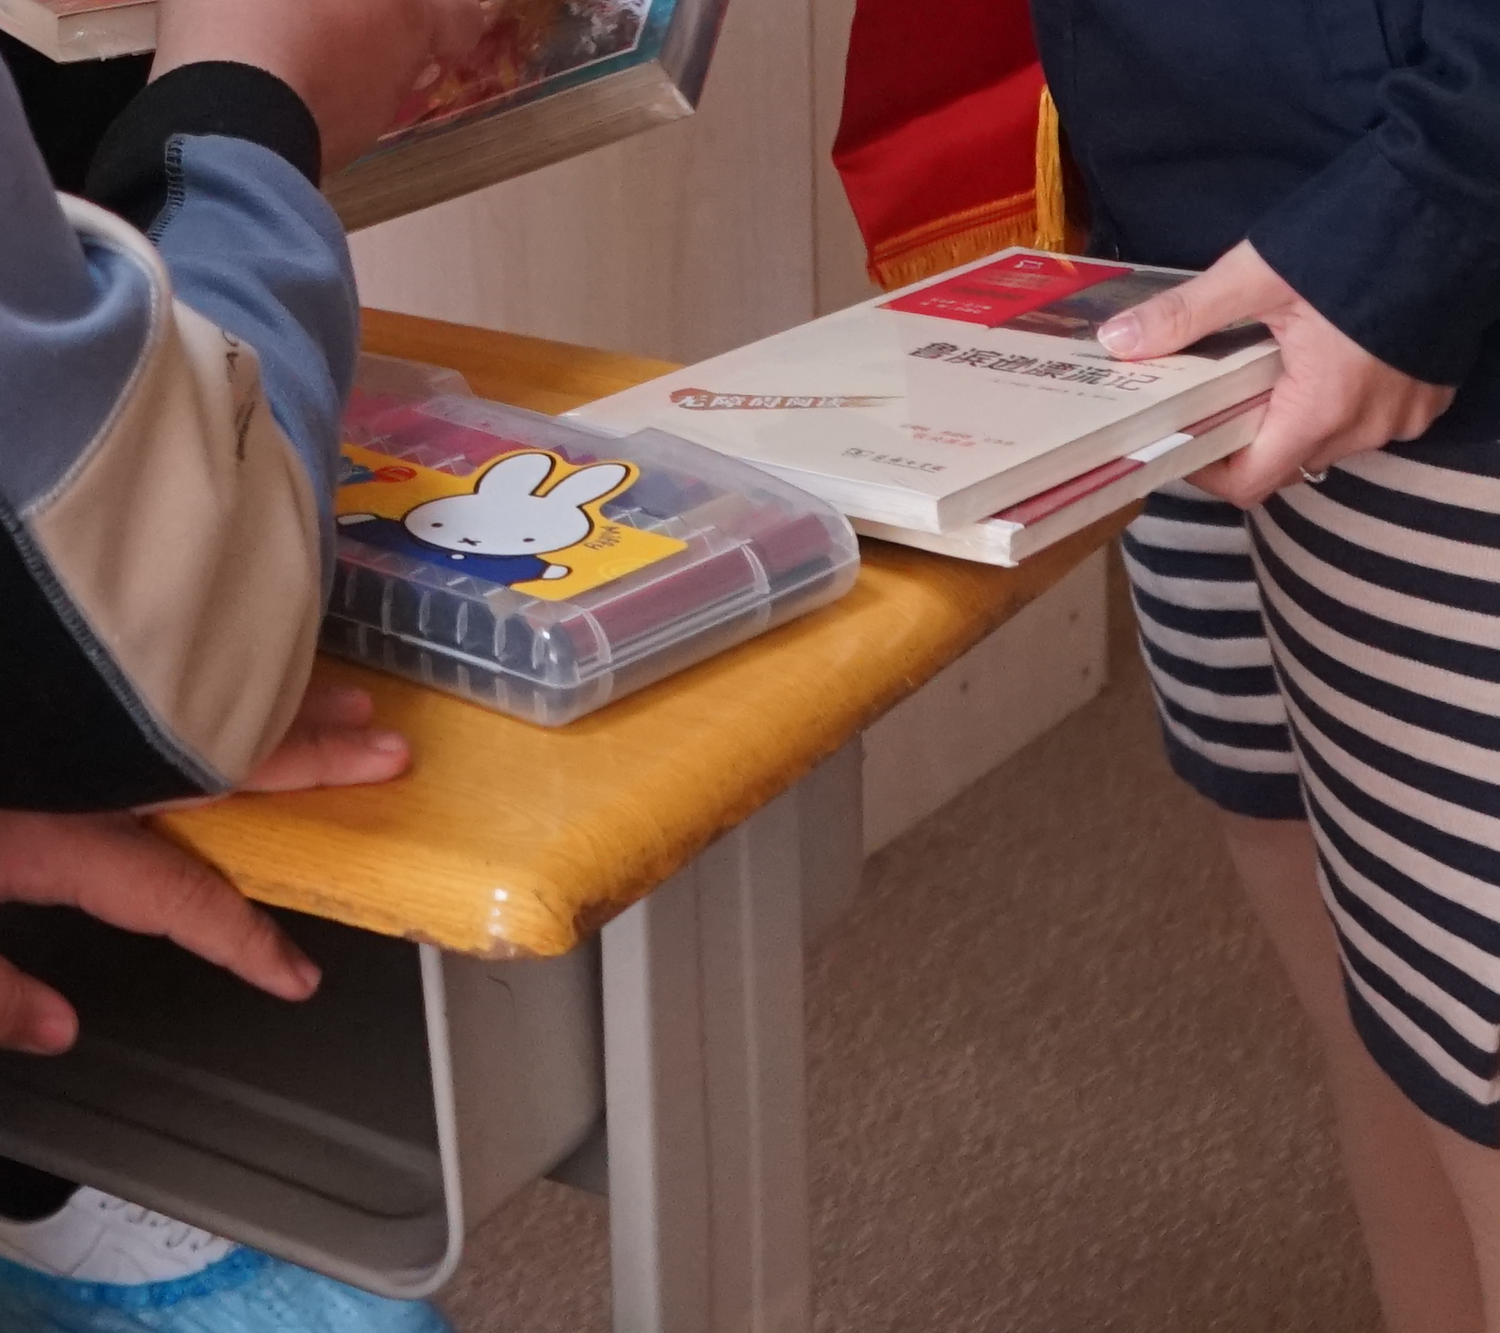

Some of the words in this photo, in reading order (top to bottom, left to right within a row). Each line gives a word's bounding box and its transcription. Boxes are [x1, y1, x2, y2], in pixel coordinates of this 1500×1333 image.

[909, 341, 1163, 392] 鲁滨逊漂流记
